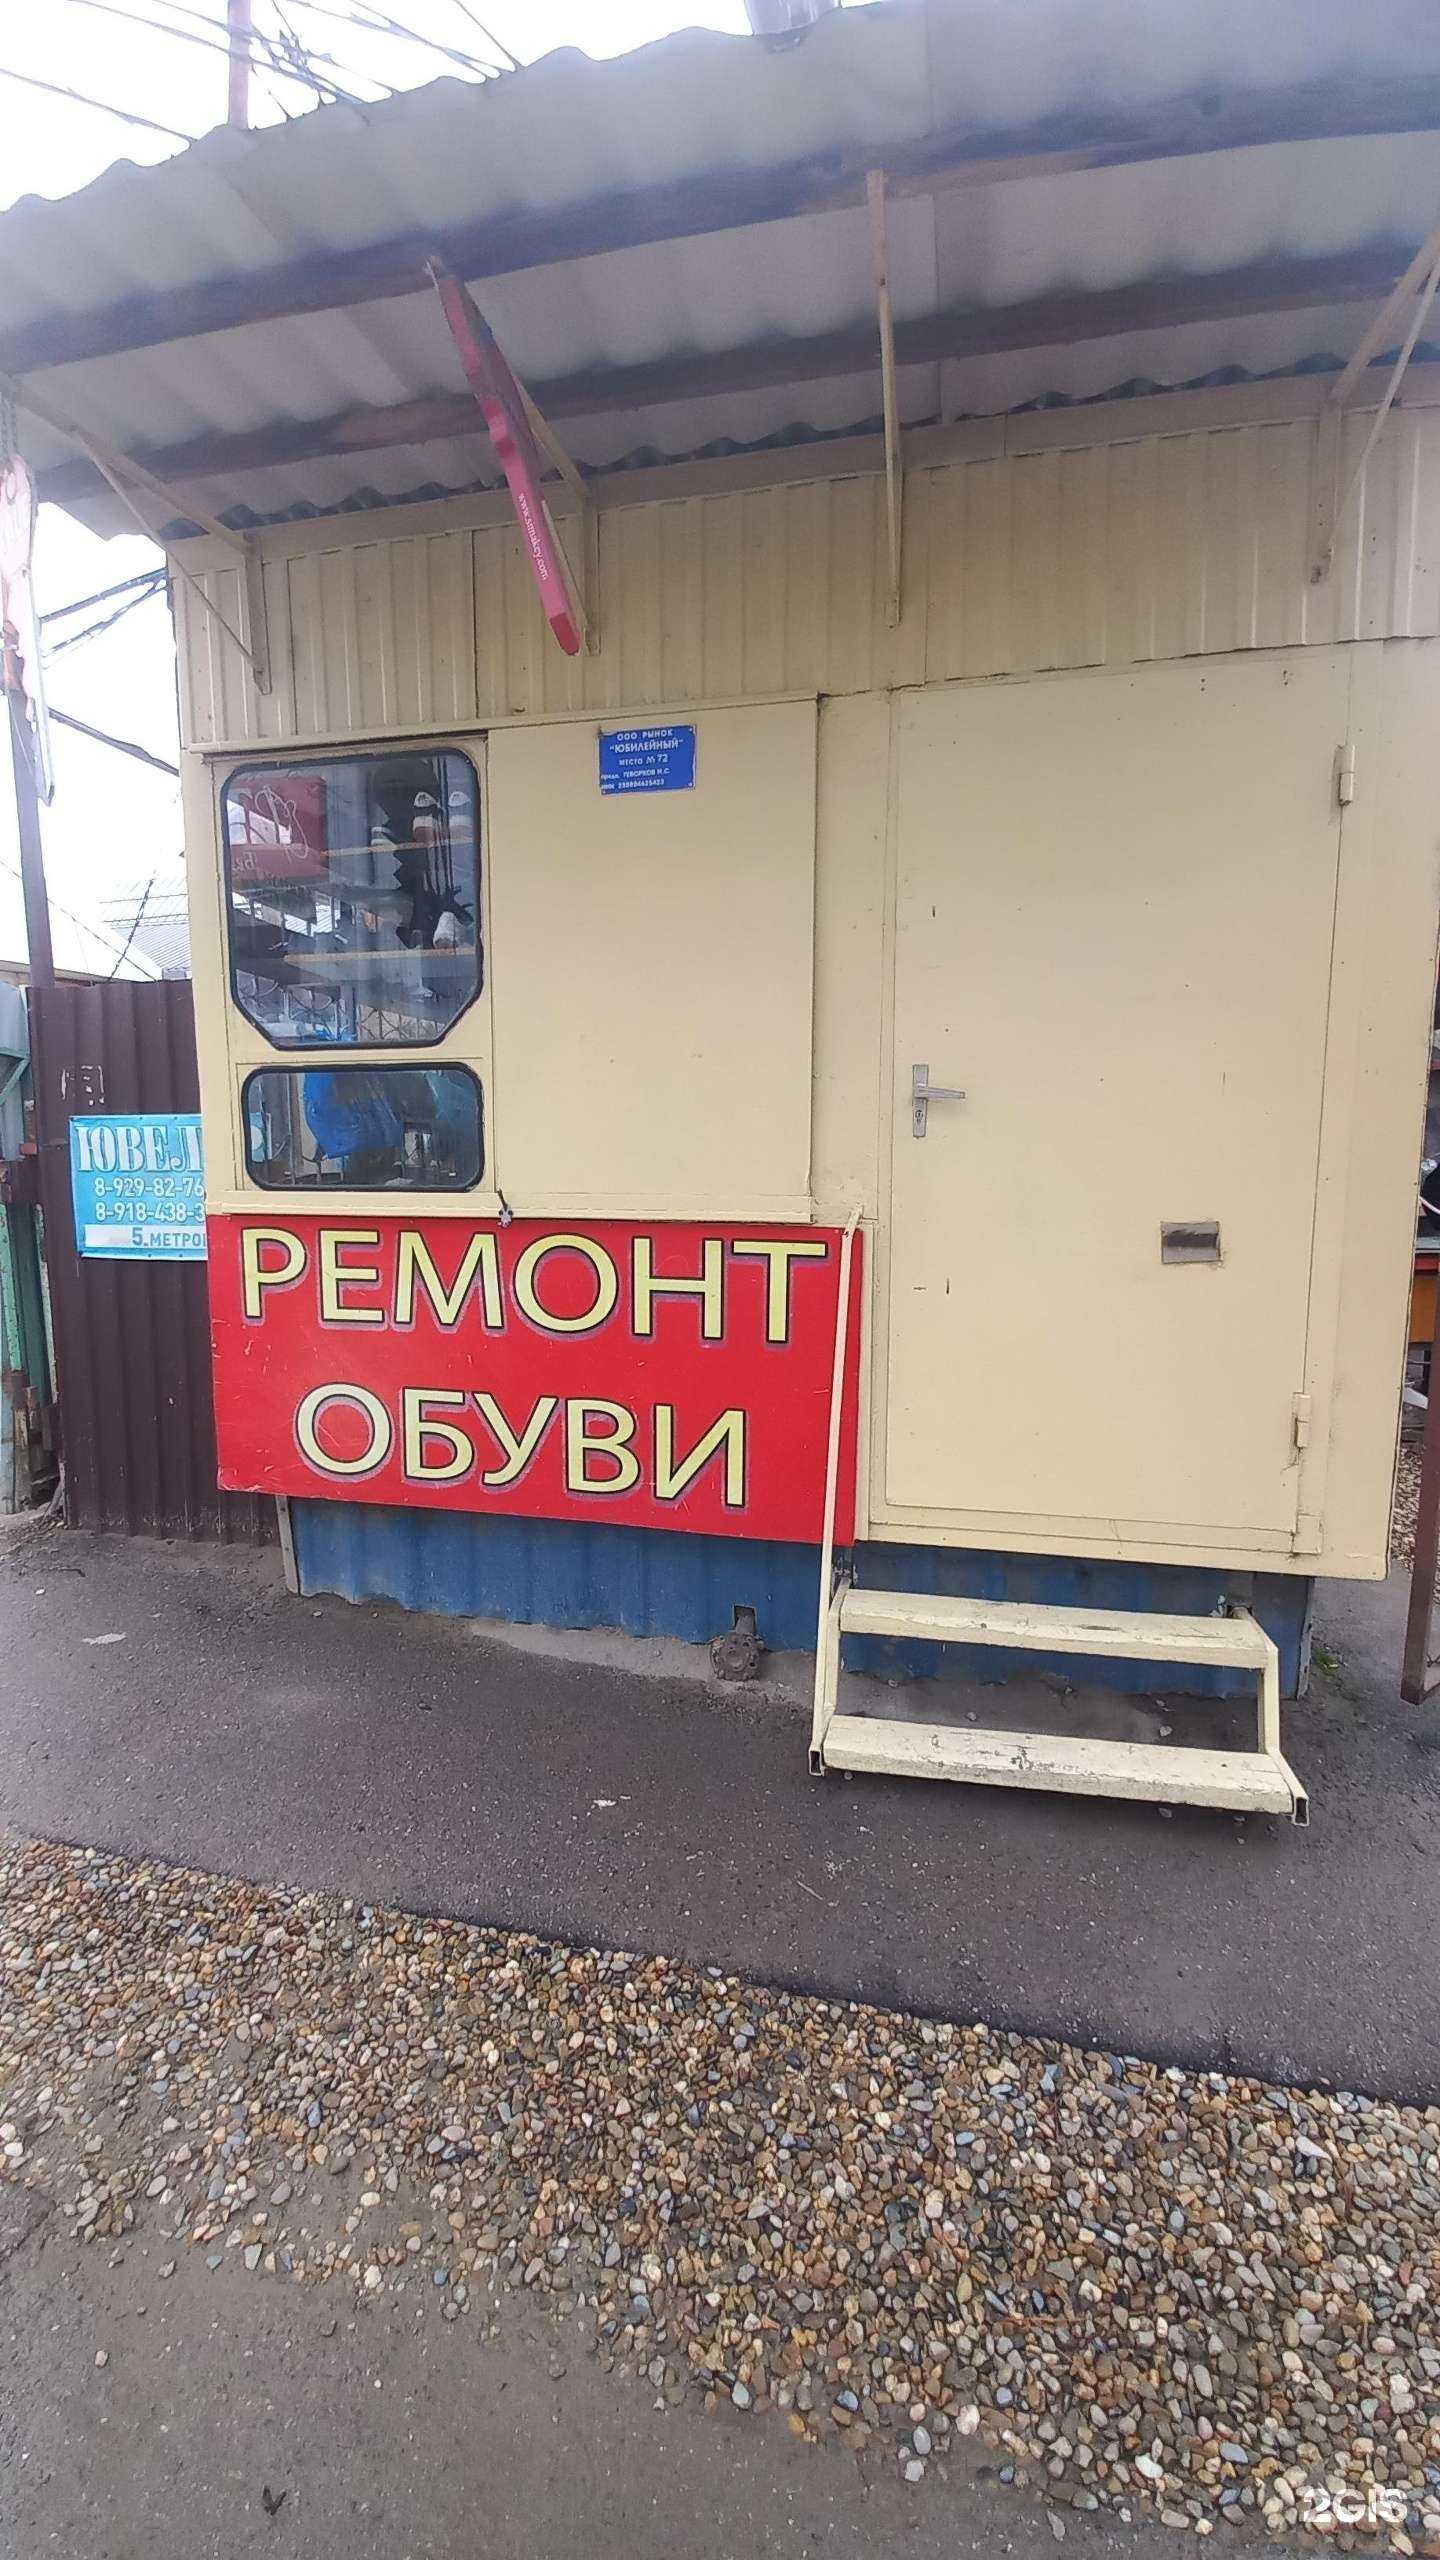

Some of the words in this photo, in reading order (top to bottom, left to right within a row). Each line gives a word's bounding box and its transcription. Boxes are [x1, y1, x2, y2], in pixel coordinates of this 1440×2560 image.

[617, 732, 638, 741] ООО
[642, 728, 674, 739] РЫНОК
[657, 753, 668, 763] 72
[94, 1177, 205, 1198] 8-929-82-76
[95, 1201, 206, 1223] 8-918-438-3
[240, 1226, 829, 1345] РЕМОНТ
[294, 1381, 748, 1509] ОБУВИ
